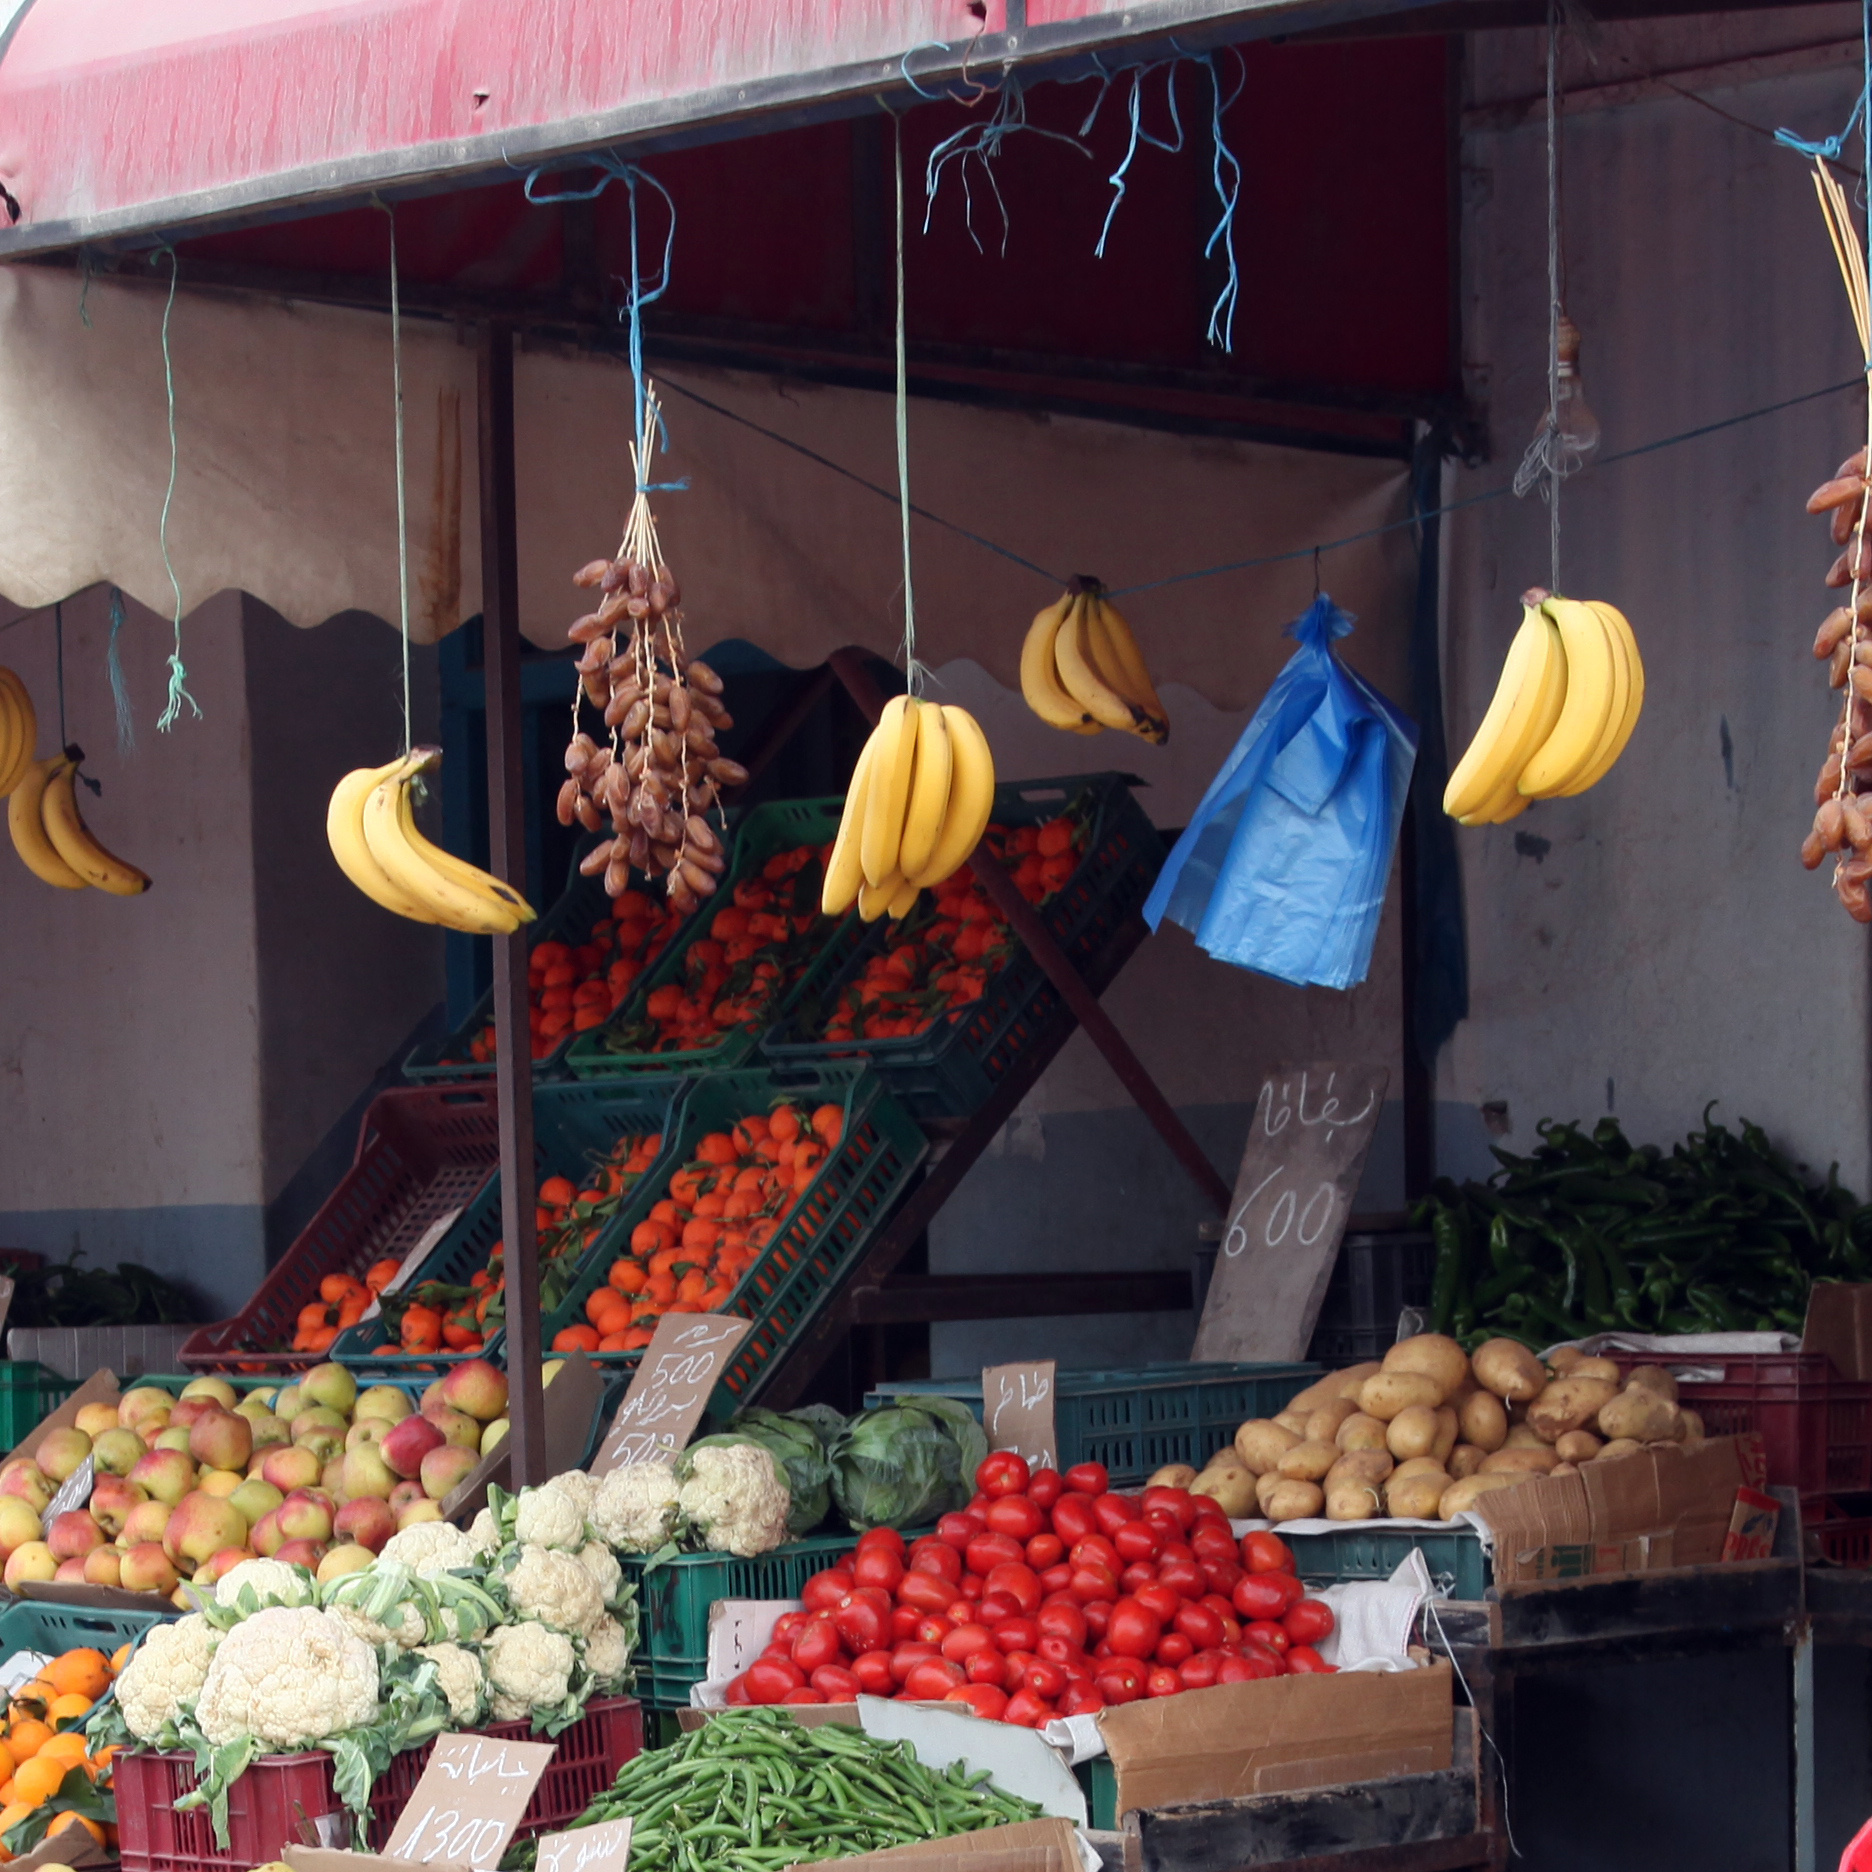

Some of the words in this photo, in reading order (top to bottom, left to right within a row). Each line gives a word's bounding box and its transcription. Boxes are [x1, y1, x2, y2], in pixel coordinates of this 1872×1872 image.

[1225, 1164, 1335, 1257] 600
[651, 1351, 716, 1389] 500
[393, 1805, 507, 1864] 1300
